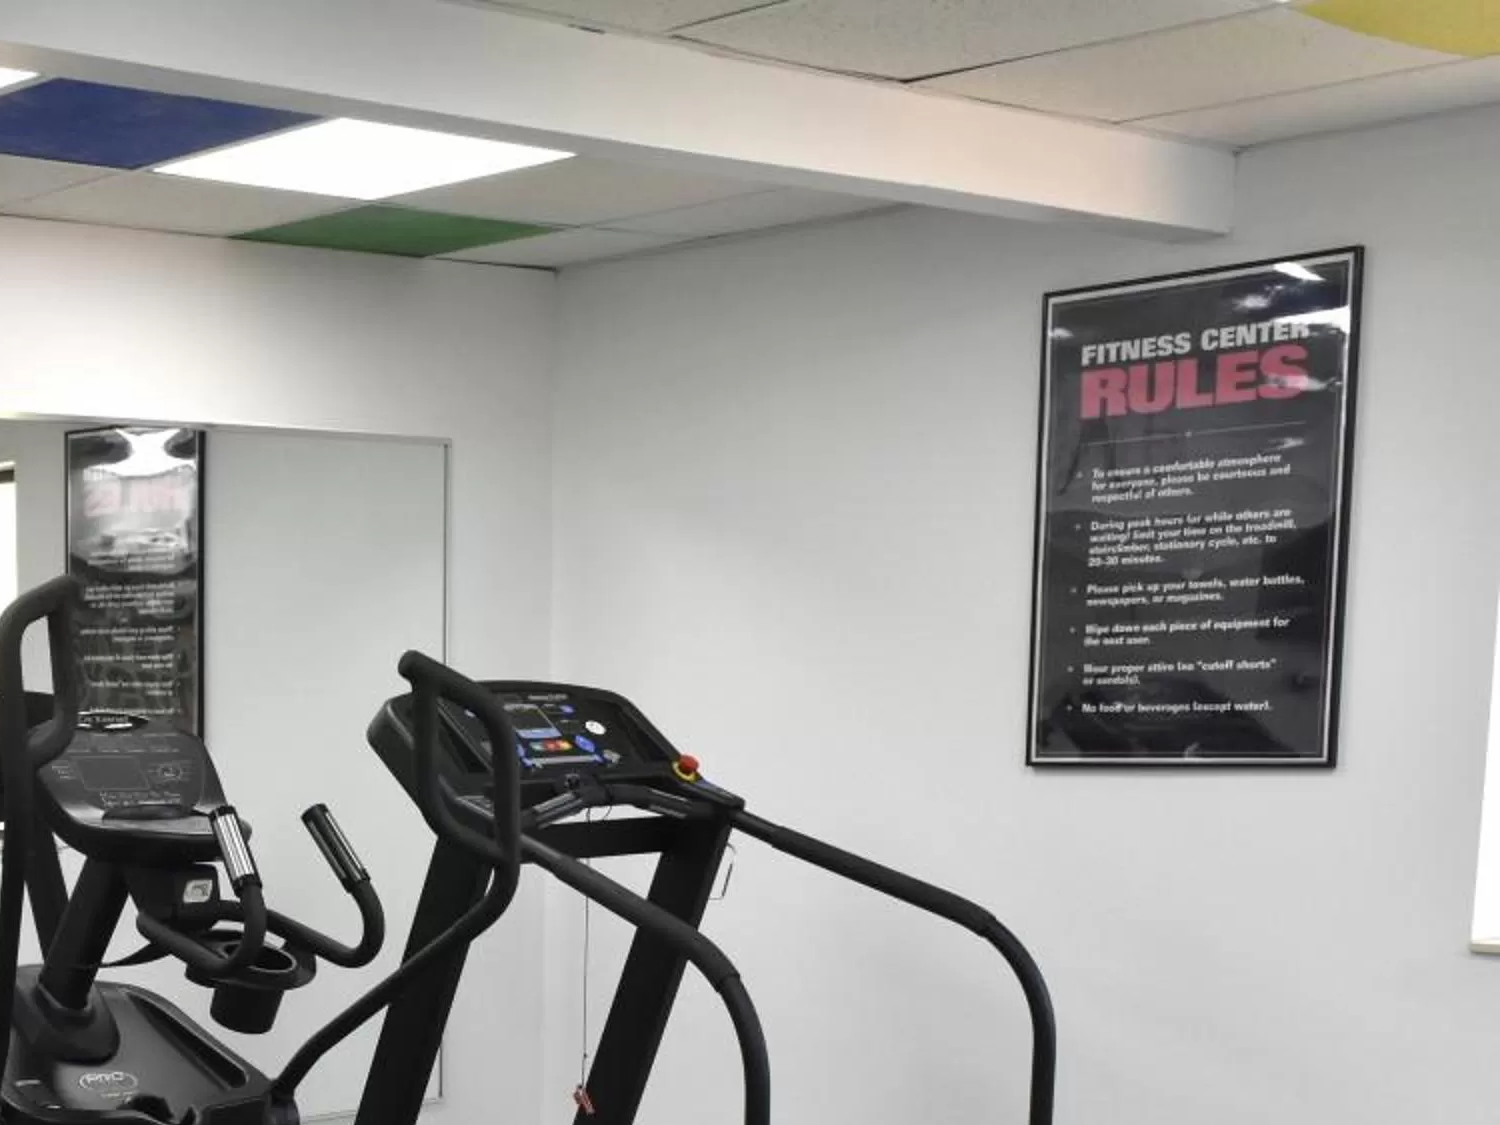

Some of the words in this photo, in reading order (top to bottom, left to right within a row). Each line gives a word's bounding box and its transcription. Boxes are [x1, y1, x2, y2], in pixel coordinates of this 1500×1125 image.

[1081, 332, 1191, 366] FITNESS
[1202, 321, 1310, 350] CENTER
[1080, 344, 1307, 419] RULES
[1093, 468, 1104, 478] To
[1153, 459, 1214, 474] comfortable
[1217, 454, 1282, 468] atmosphere
[1161, 475, 1194, 487] please
[1213, 469, 1266, 480] courteous
[1270, 464, 1290, 475] and
[1091, 521, 1124, 532] During
[1154, 516, 1183, 526] hours
[1236, 510, 1270, 520] others
[1158, 529, 1181, 540] your
[1184, 527, 1206, 536] time
[1209, 527, 1222, 535] on
[1226, 525, 1242, 534] the
[1153, 540, 1205, 550] stationary
[1087, 584, 1119, 594] Please
[1122, 582, 1142, 594] pick
[1163, 582, 1185, 592] your
[1230, 578, 1259, 587] water
[1142, 621, 1167, 632] each
[1170, 621, 1198, 632] piece
[1201, 619, 1212, 630] of
[1214, 618, 1270, 630] equipment
[1273, 617, 1291, 627] for
[1111, 664, 1144, 675] proper
[1138, 702, 1190, 713] beverages
